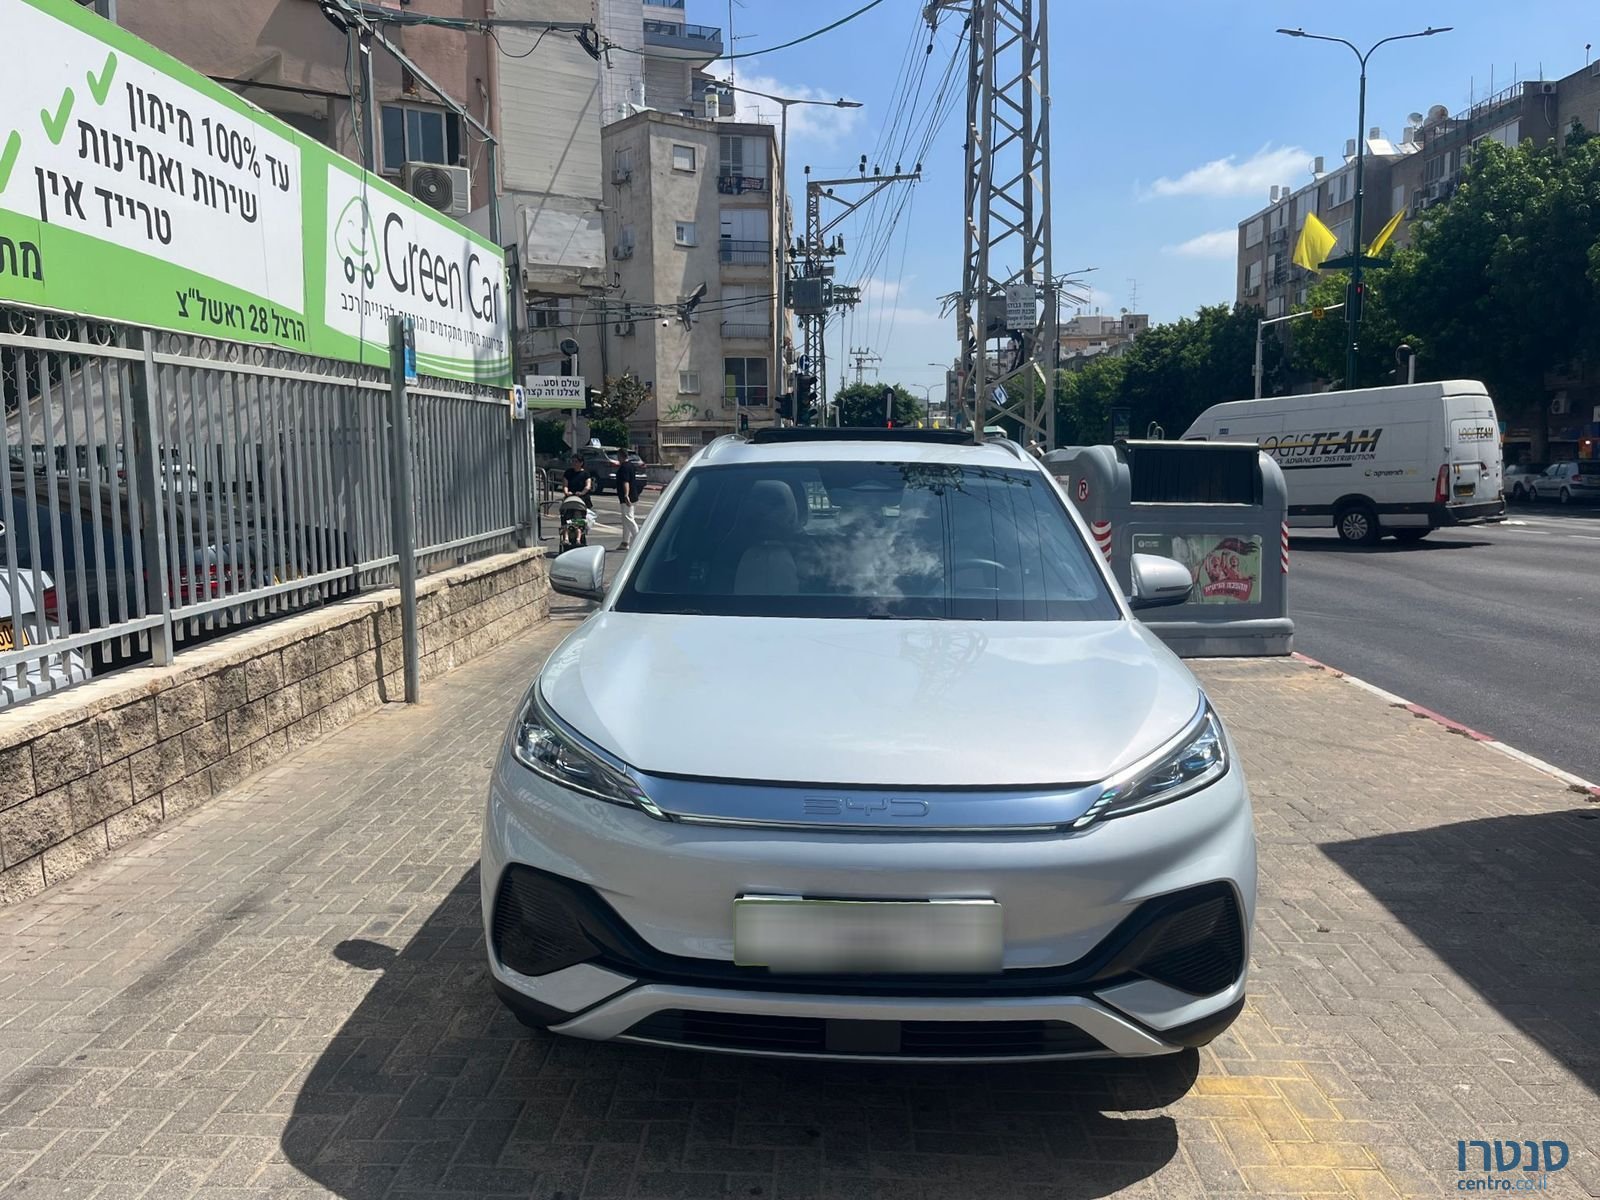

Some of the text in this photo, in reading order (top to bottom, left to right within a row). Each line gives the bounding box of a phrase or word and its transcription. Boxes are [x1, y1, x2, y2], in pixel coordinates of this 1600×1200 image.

[126, 82, 291, 193] עד 100% מימון
[77, 118, 258, 224] שירות ואמינות
[34, 166, 172, 246] טרייד אין
[384, 211, 501, 325] Green Car
[340, 292, 361, 314] רכב
[248, 304, 269, 335] 28
[270, 308, 306, 343] הרצל
[544, 388, 554, 396] זה
[557, 387, 580, 397] אצלנו
[561, 378, 580, 388] שלם
[1286, 455, 1322, 465] ADVANCED
[1323, 453, 1377, 463] DISTRIBUTION
[802, 795, 929, 817] BYD
